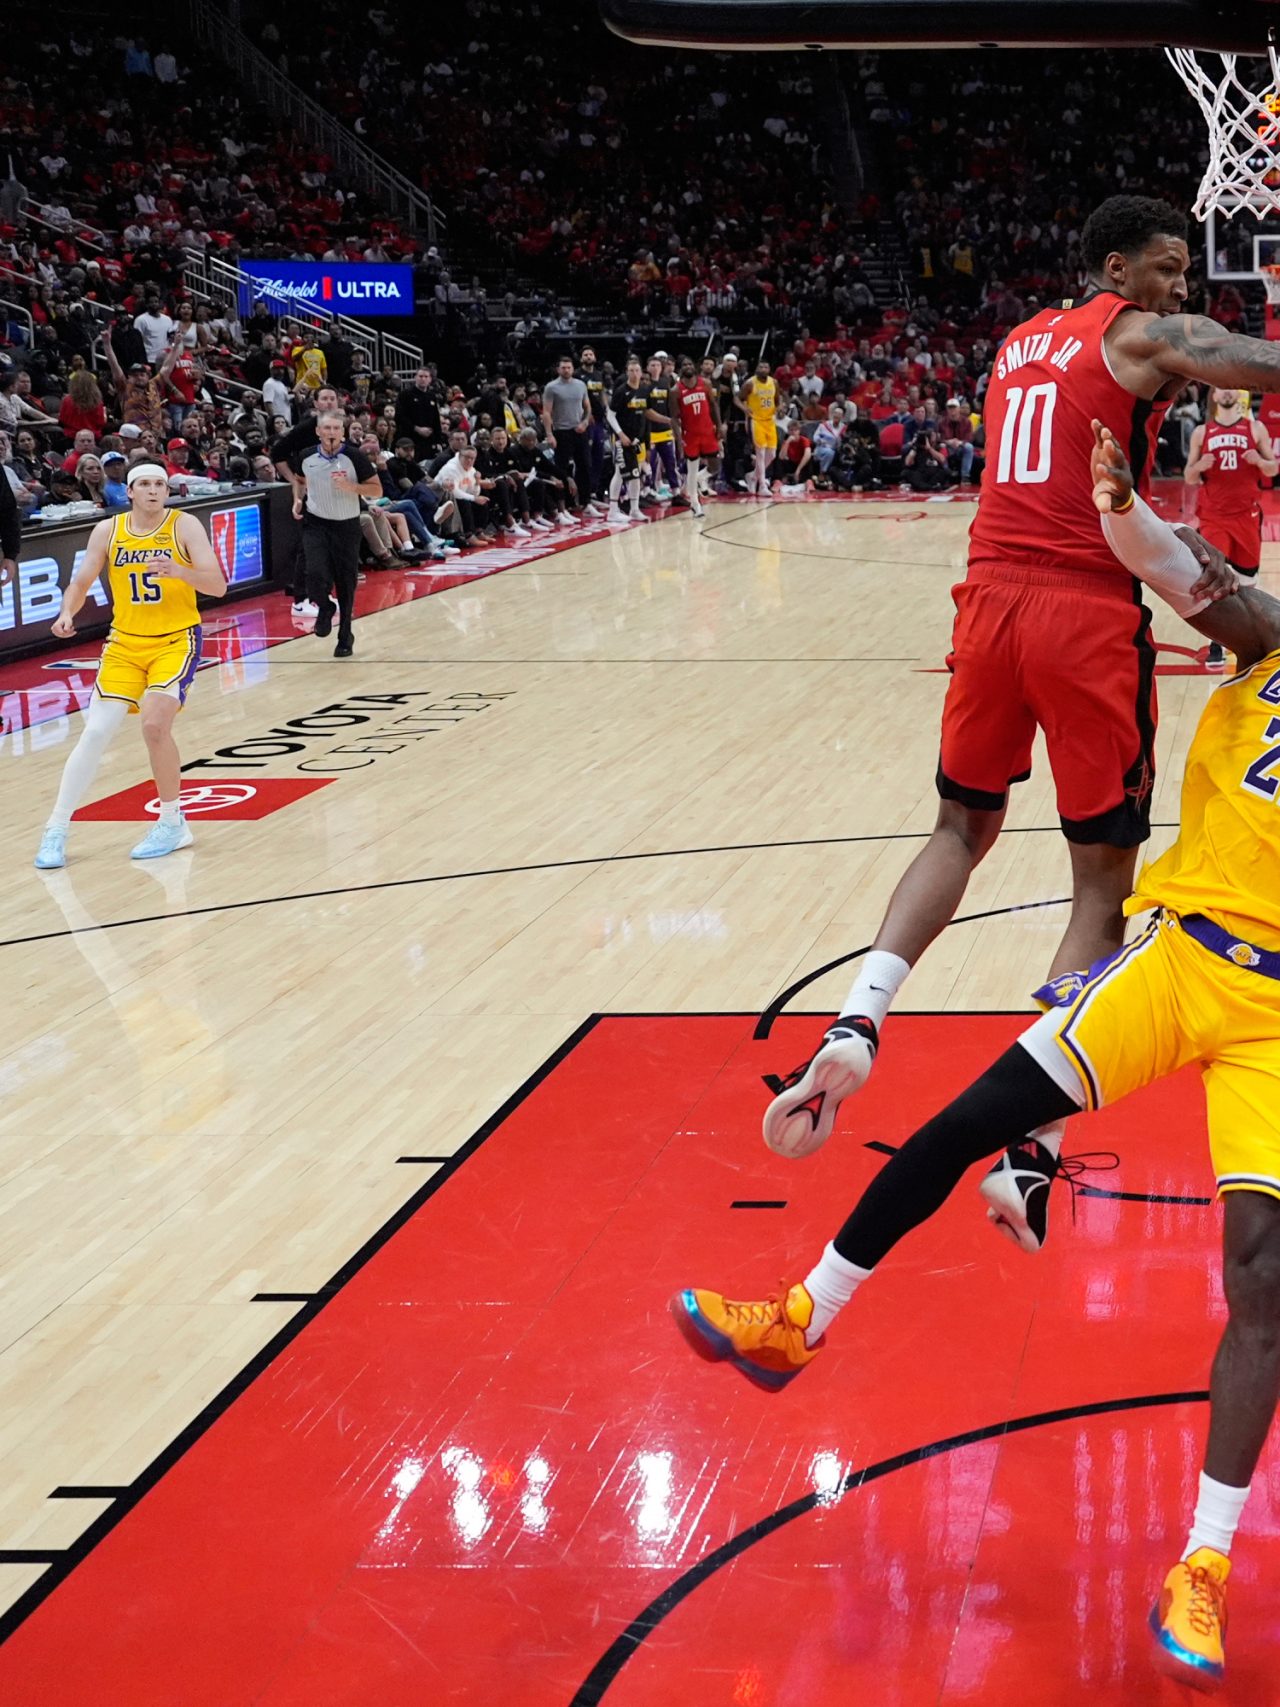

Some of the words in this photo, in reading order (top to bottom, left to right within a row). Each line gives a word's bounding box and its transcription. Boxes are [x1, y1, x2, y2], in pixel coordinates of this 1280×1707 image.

[337, 281, 401, 298] ULTRA
[997, 332, 1053, 380] SMITH
[1050, 336, 1083, 373] JR.
[996, 381, 1058, 484] 10
[1219, 450, 1238, 471] 28
[129, 572, 162, 603] 15
[180, 691, 432, 774] TOYOTA
[296, 690, 517, 773] CENTER
